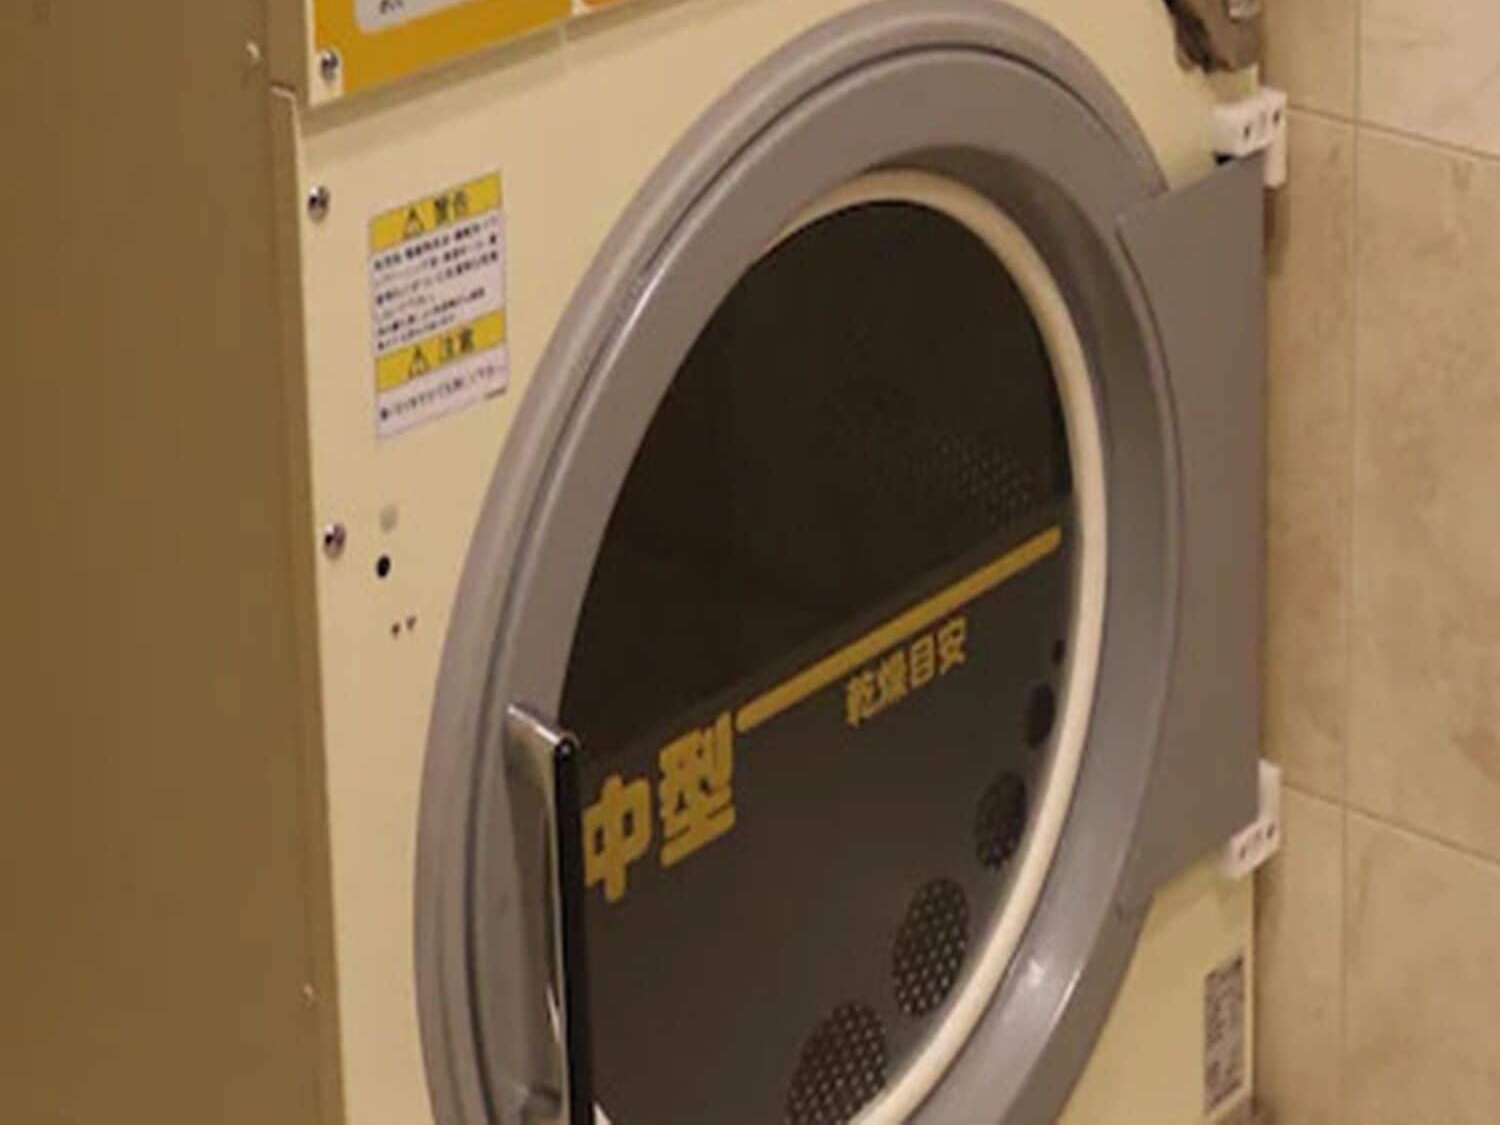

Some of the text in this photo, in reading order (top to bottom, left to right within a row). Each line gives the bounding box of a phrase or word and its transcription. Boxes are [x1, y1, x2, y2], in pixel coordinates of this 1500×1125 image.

[846, 618, 966, 726] 乾燥目安
[582, 712, 736, 903] 中型
